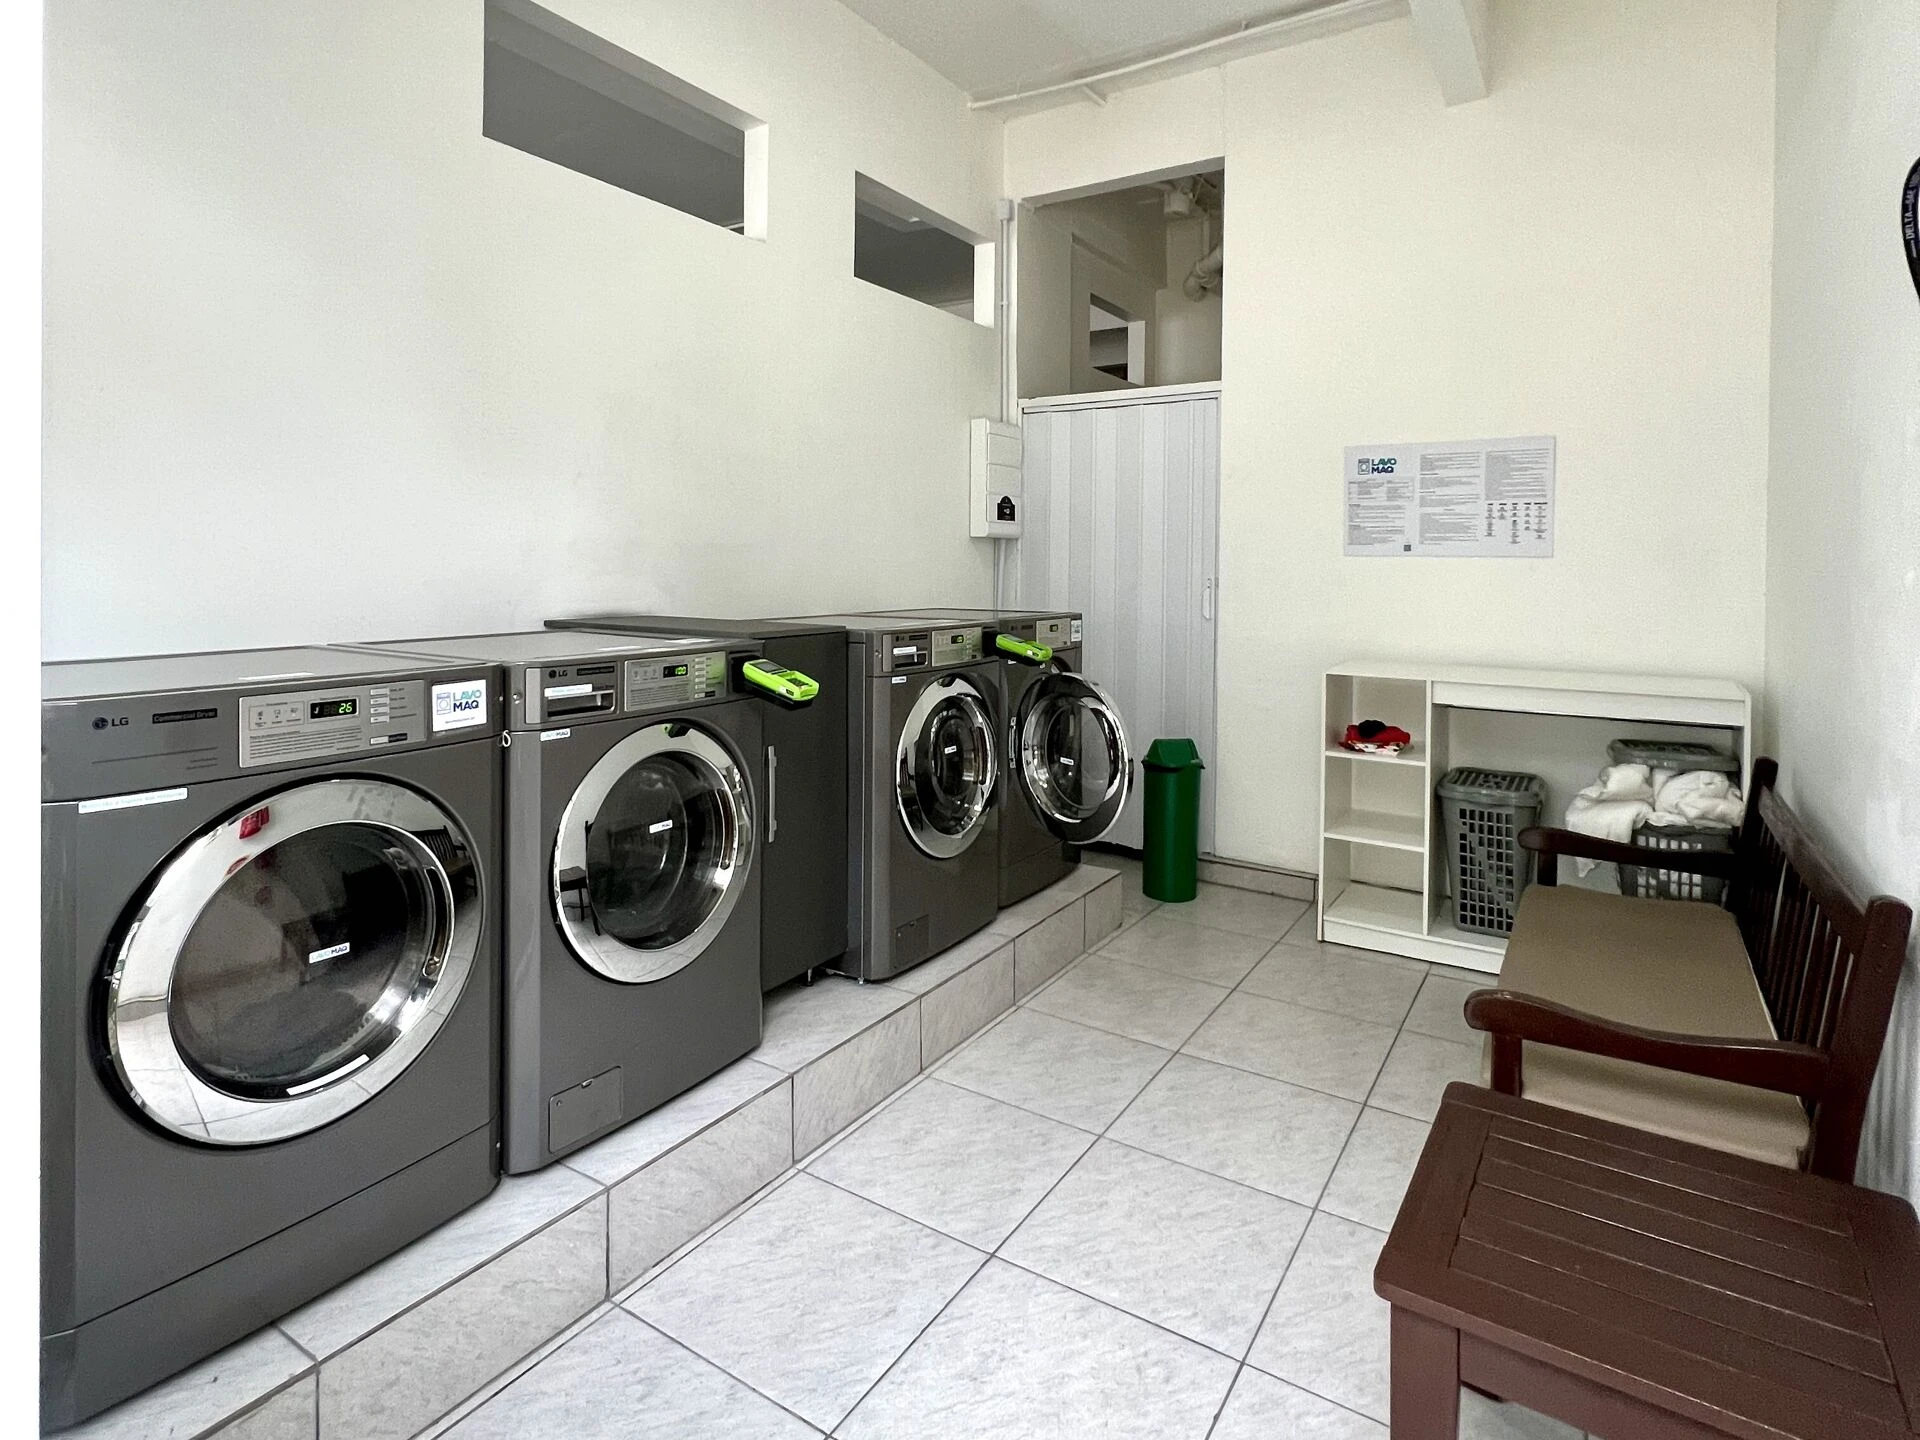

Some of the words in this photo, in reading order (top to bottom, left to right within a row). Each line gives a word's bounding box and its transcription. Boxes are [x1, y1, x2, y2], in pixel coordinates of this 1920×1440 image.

[1371, 458, 1397, 466] LAVO
[1371, 466, 1394, 474] MAQ
[558, 669, 568, 677] LG
[453, 690, 482, 702] LAVO
[339, 702, 353, 714] 26
[453, 699, 480, 712] MAQ
[154, 711, 196, 722] Commercial
[111, 717, 129, 727] LG
